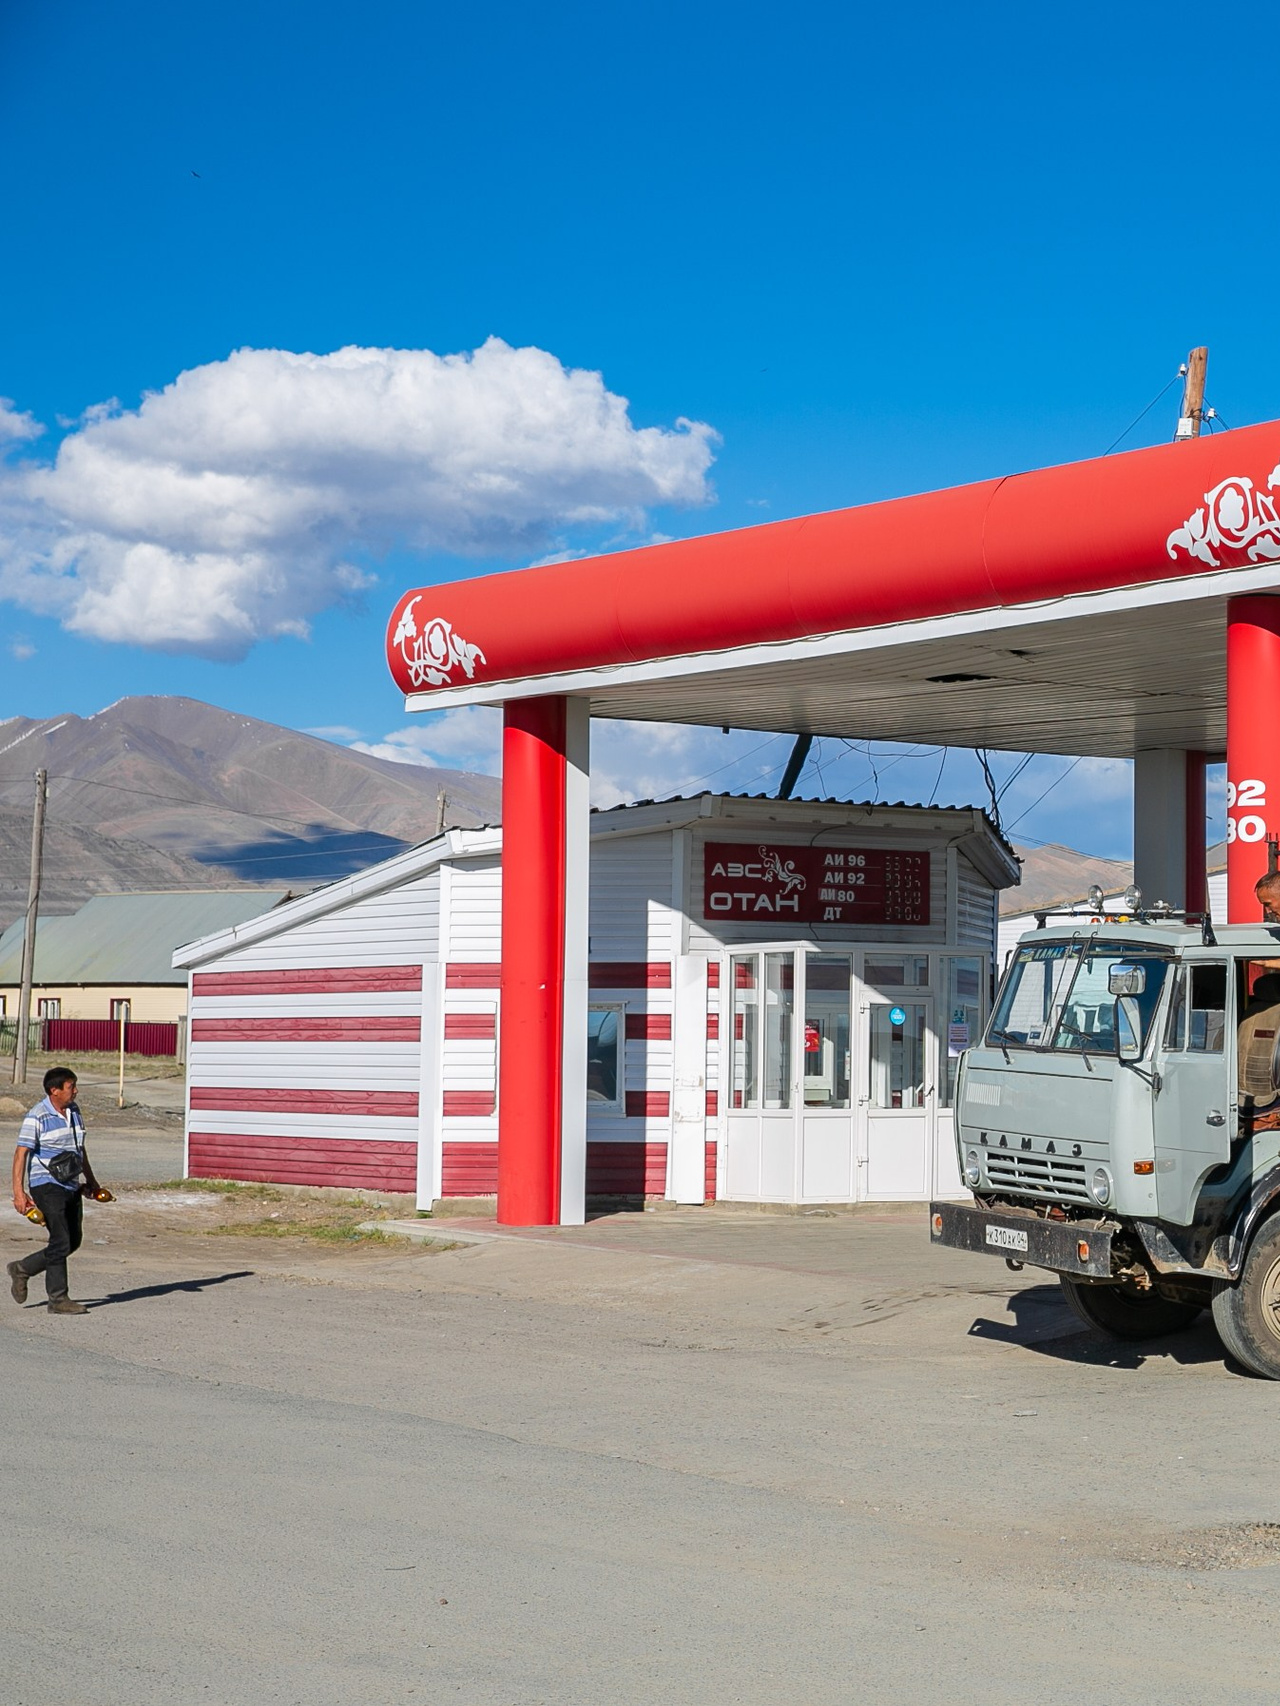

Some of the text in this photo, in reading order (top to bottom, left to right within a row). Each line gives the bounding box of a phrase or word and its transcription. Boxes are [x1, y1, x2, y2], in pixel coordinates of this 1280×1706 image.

[824, 853, 866, 867] АИ 96
[711, 862, 762, 878] АЗС
[824, 871, 865, 885] АИ 92
[710, 892, 799, 912] ОТАН
[837, 890, 855, 902] 80
[823, 906, 842, 921] ДТ
[980, 1131, 1082, 1157] КАМАЗ
